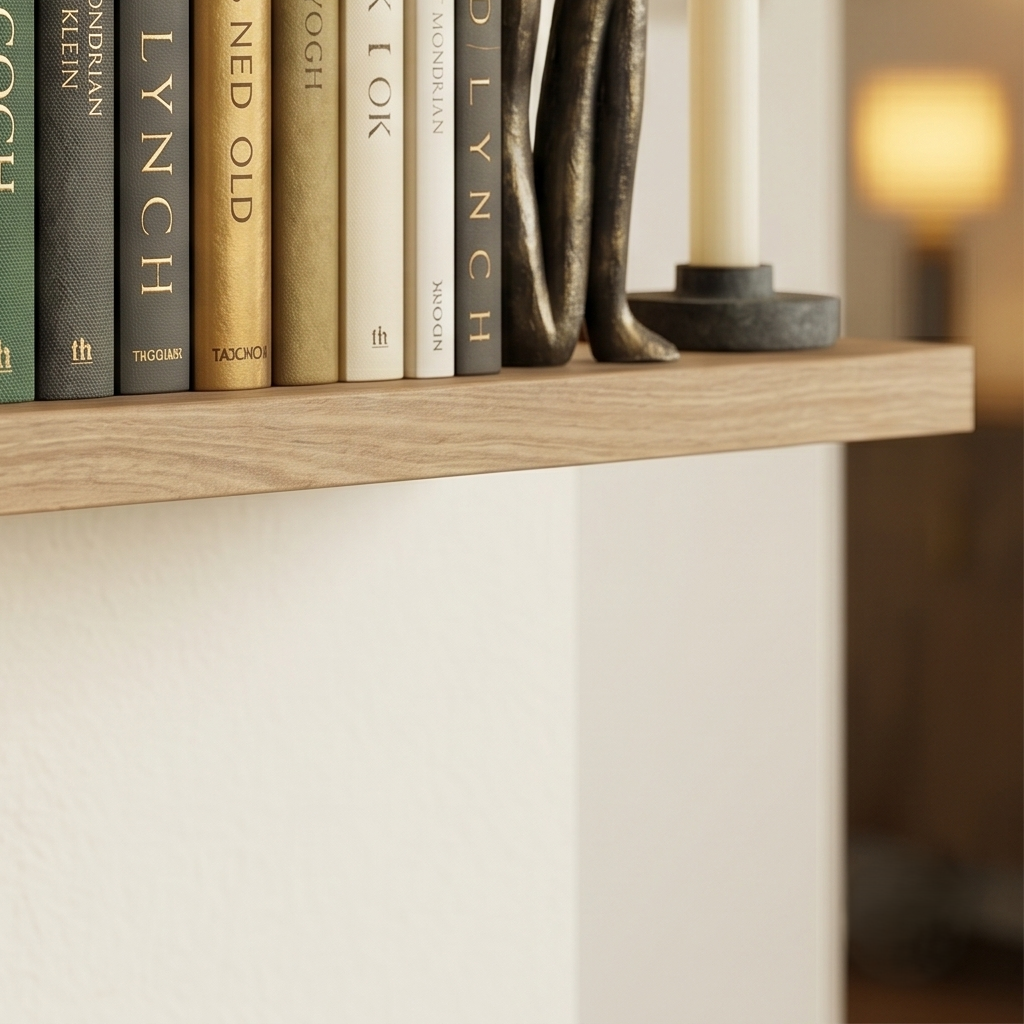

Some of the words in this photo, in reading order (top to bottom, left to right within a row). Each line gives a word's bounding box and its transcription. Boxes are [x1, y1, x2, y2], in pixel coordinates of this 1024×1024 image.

[61, 9, 79, 89] KLEIN
[229, 21, 253, 111] NED
[432, 12, 444, 135] MONDRIAN
[367, 76, 392, 139] OK
[141, 31, 173, 295] LYNCH
[229, 136, 253, 224] OLD
[469, 77, 491, 342] LYNCH
